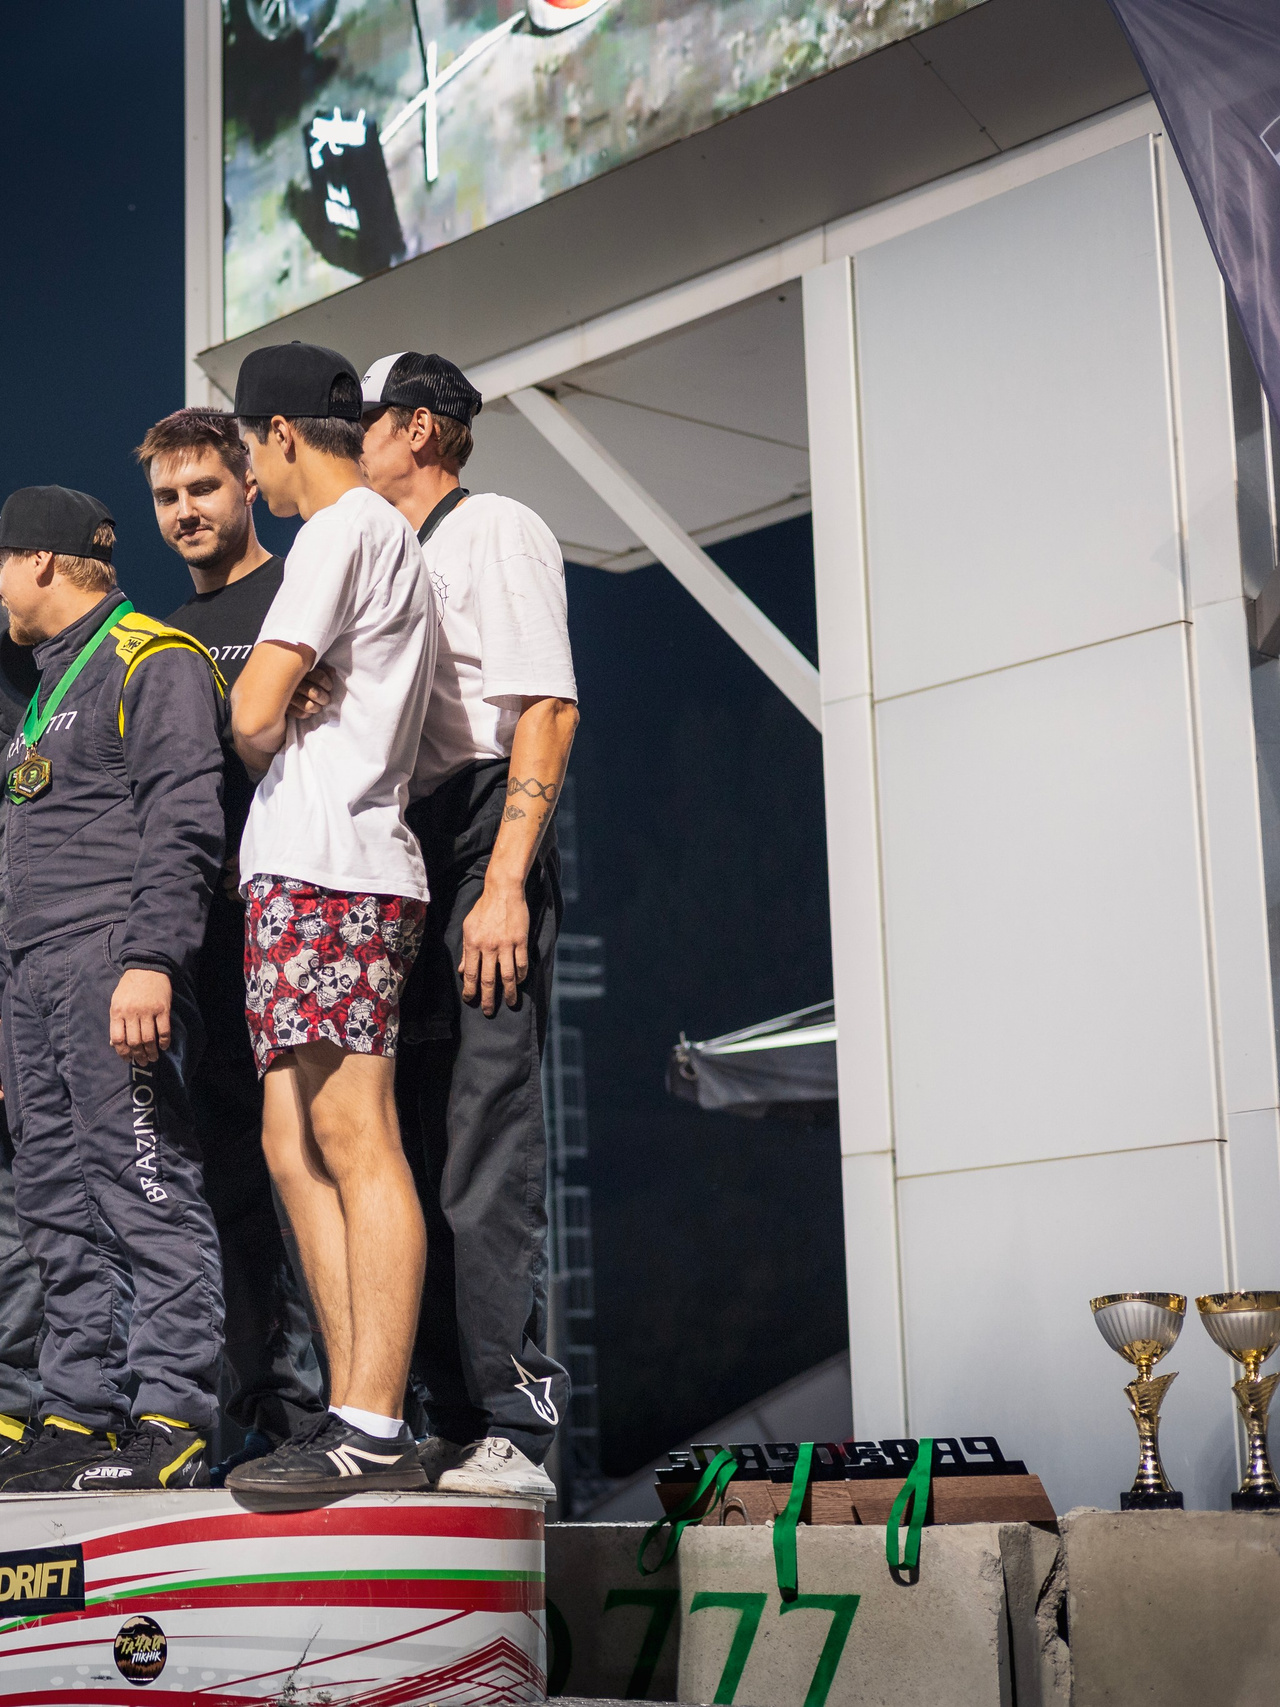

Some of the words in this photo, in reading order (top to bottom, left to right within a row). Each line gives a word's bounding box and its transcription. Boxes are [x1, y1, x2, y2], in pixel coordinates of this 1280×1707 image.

[221, 645, 253, 661] 777
[46, 711, 78, 735] 777
[132, 1084, 168, 1203] BRAZINO
